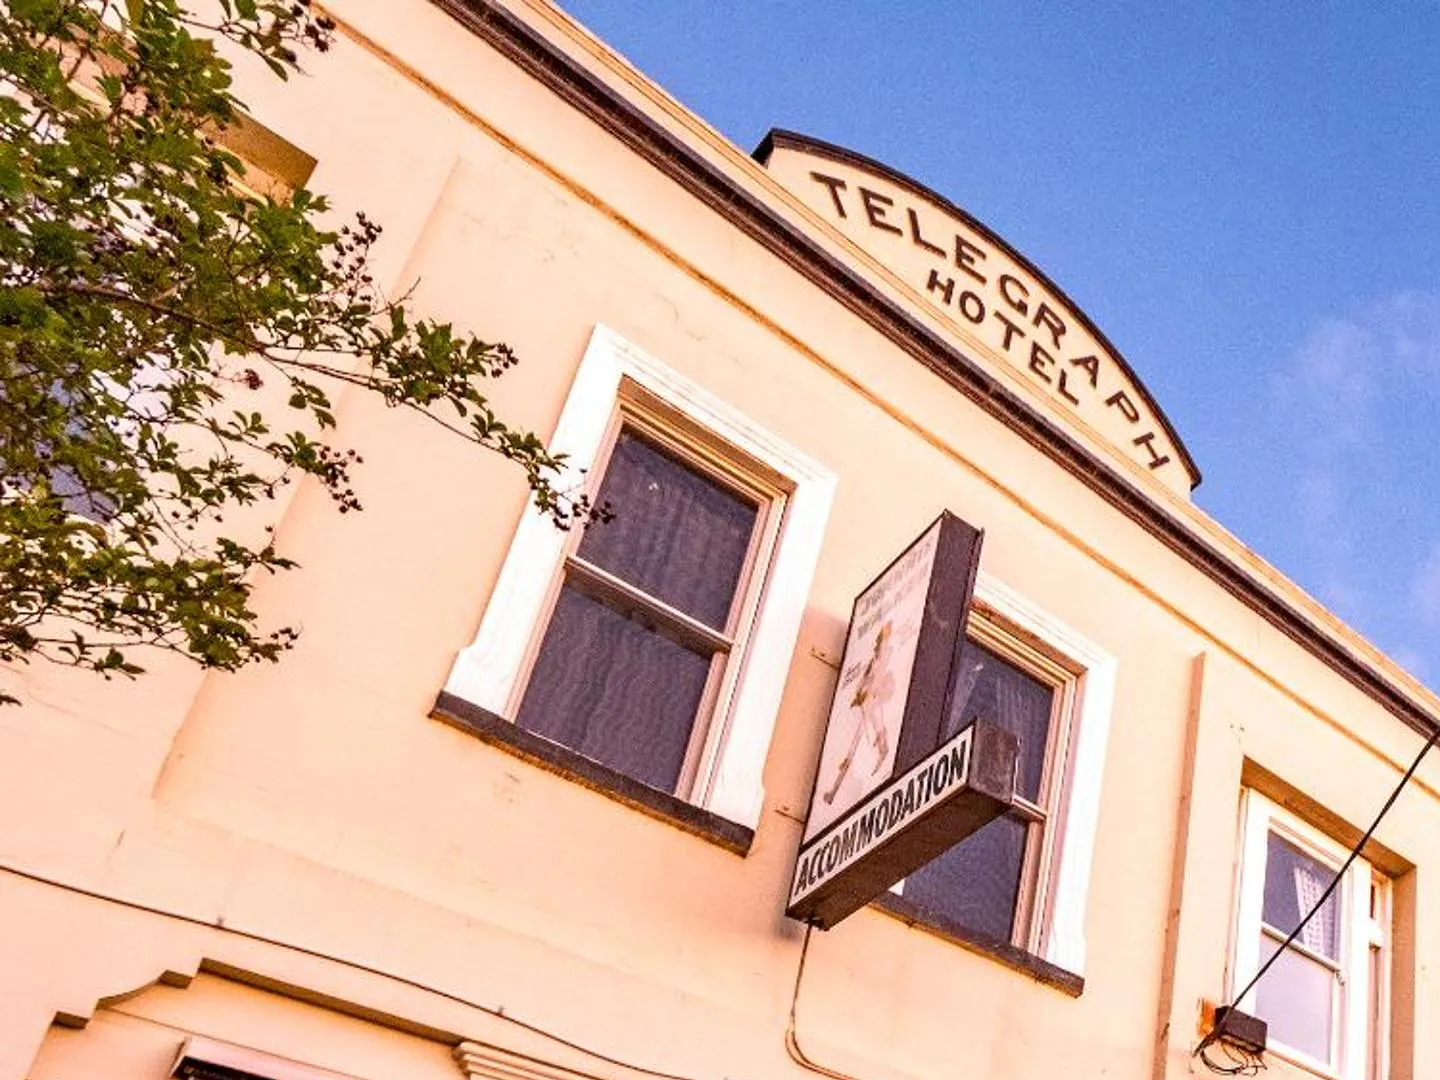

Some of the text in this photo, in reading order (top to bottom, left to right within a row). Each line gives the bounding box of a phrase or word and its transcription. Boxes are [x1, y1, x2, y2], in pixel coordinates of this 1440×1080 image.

[810, 171, 1170, 470] TELEGRAPH
[927, 269, 1080, 405] HOTEL
[794, 740, 967, 897] ACCOMMODATION
